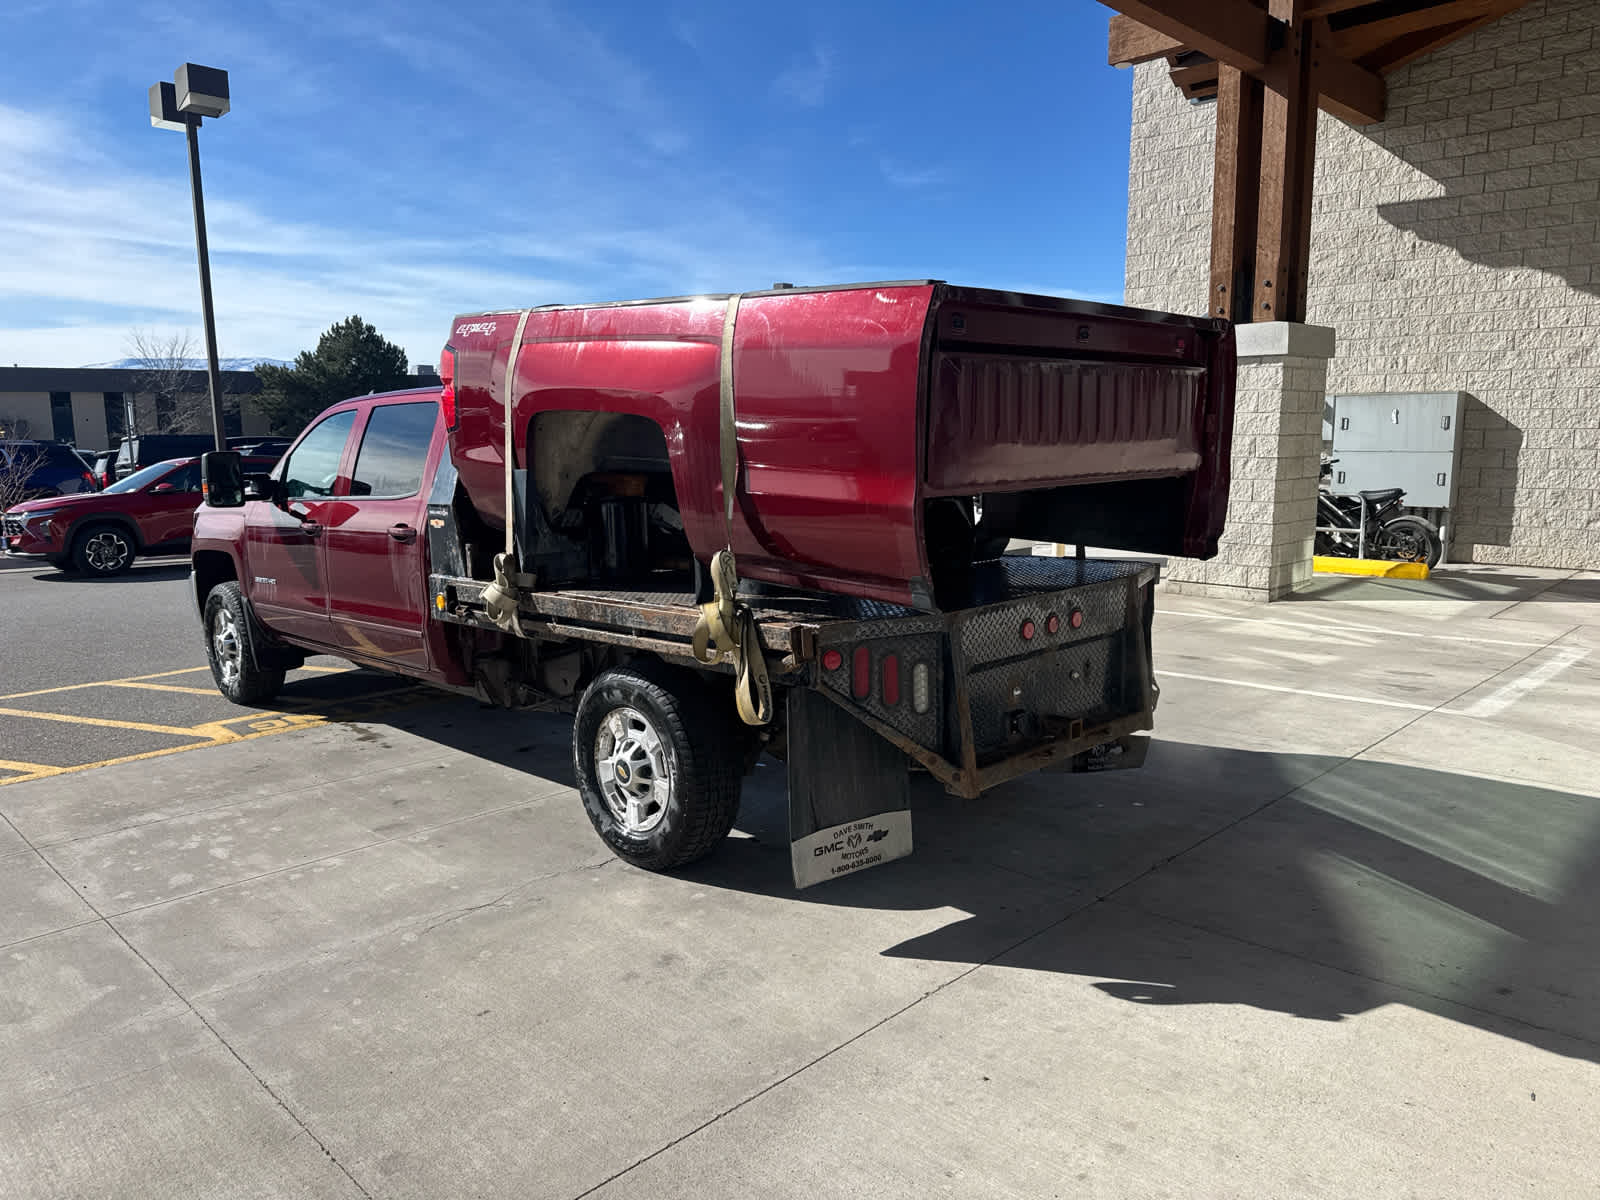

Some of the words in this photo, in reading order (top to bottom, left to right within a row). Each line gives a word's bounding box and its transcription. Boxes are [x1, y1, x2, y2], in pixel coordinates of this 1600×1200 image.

[833, 825, 852, 840] DAVE
[853, 822, 874, 832] SMITH
[814, 841, 845, 857] GMC
[841, 846, 869, 860] MOTORS
